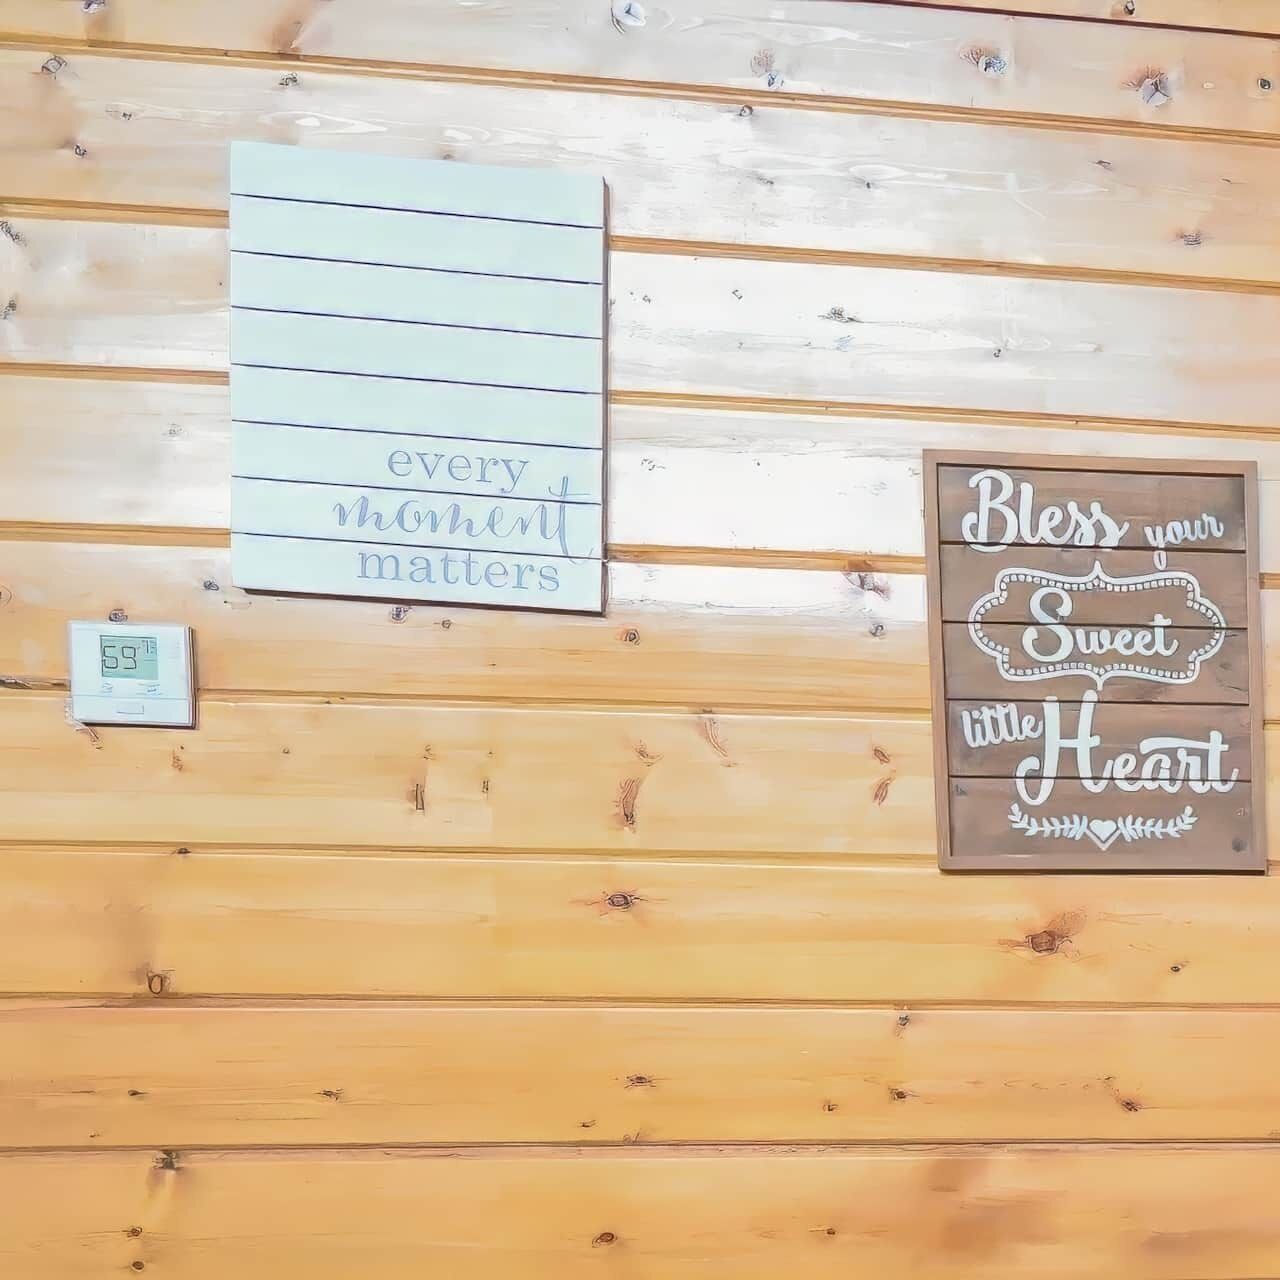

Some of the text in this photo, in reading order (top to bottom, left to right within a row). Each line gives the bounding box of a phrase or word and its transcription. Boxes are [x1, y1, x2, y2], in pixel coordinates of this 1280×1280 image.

[387, 448, 529, 493] every
[333, 475, 595, 564] moment
[961, 469, 1225, 571] Bless your
[356, 550, 561, 592] matters
[1021, 586, 1180, 663] Sweet
[960, 689, 1240, 806] little Heart
